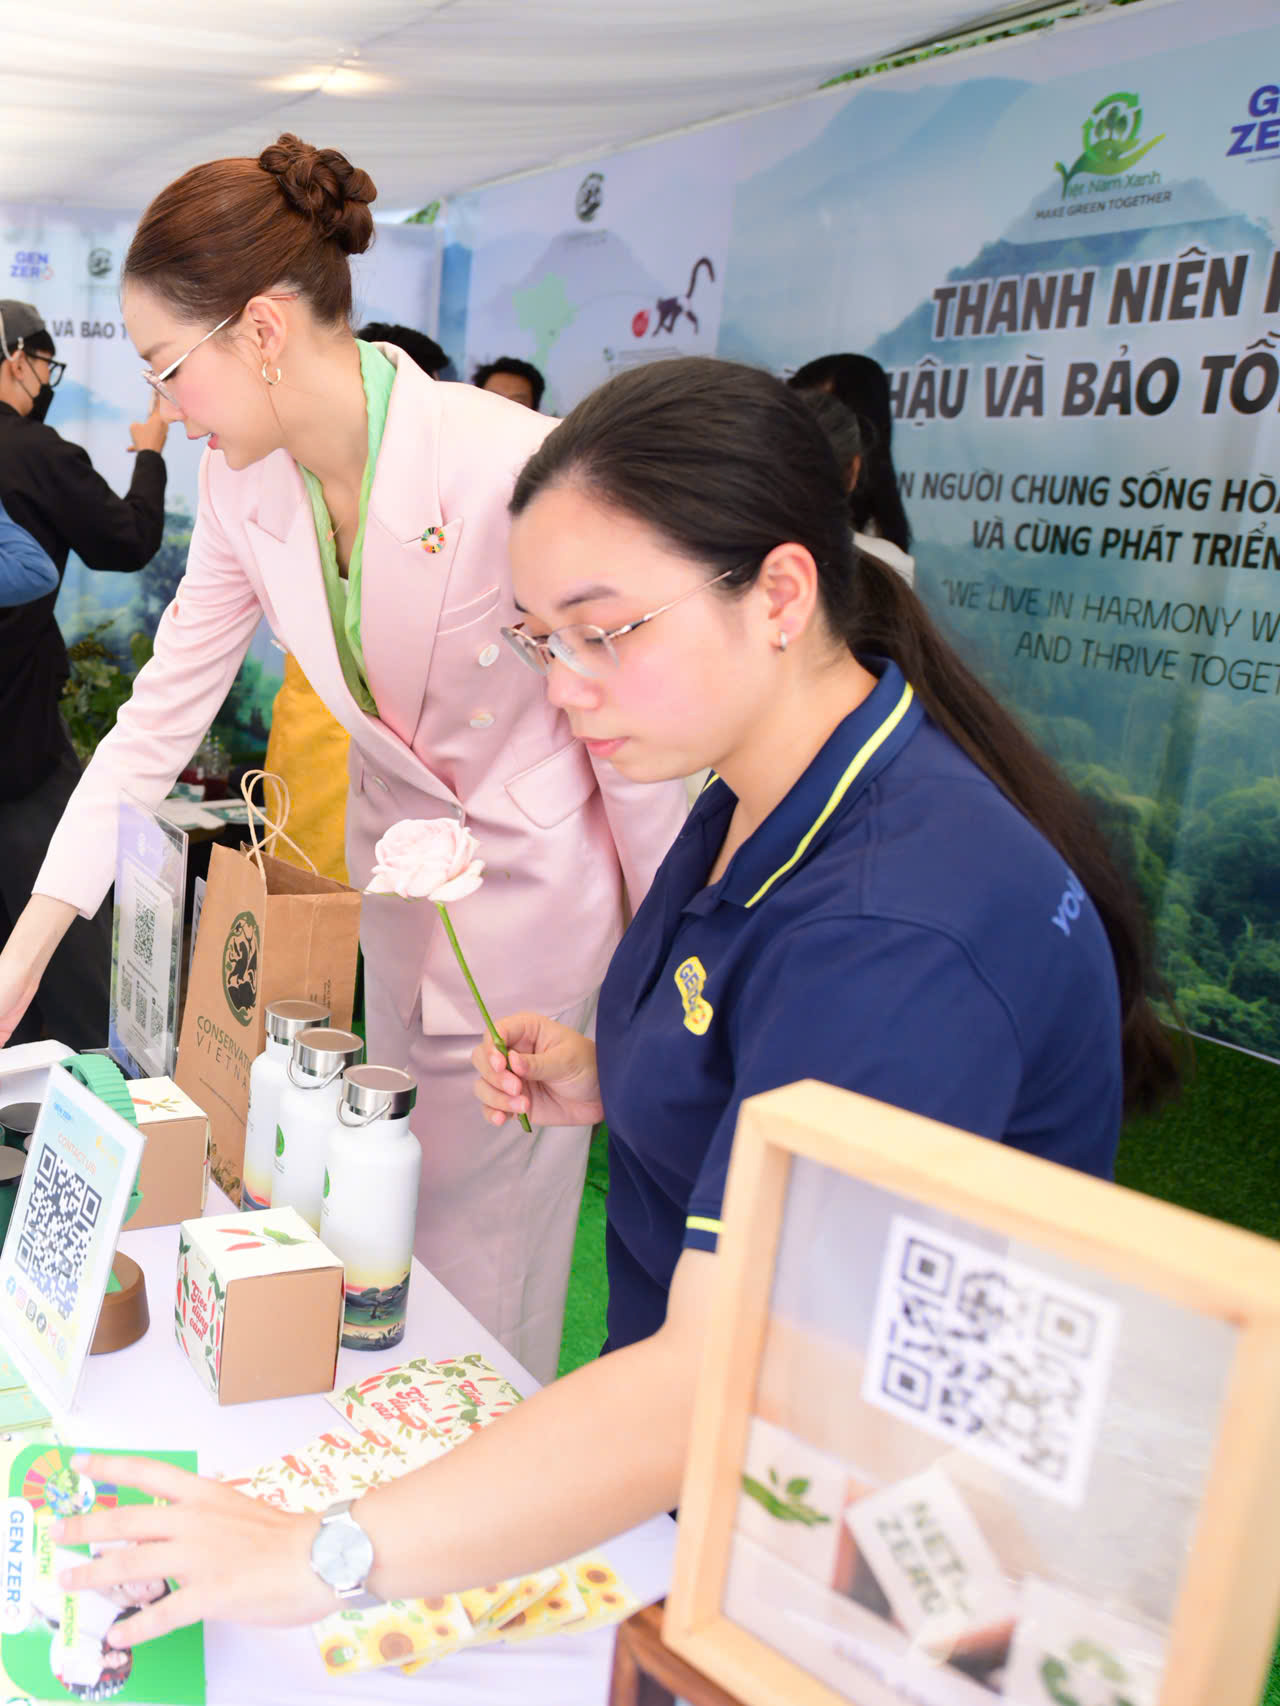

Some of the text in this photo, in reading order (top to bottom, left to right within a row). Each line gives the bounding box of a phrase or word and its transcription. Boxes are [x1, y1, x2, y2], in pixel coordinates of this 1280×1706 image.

[1067, 199, 1105, 217] GREEN
[1108, 190, 1173, 210] TOGETHER
[15, 250, 49, 265] GEN
[932, 271, 1096, 339] THANH
[1108, 246, 1250, 326] NIÊN
[985, 353, 1045, 418] VÀ
[1062, 344, 1181, 417] BẢO
[1201, 331, 1280, 415] TỒ
[921, 467, 1004, 502] NGƯỜI
[1011, 473, 1111, 507] CHUNG
[1120, 466, 1212, 512] SỐNG
[1221, 473, 1280, 514] HÒ
[973, 514, 1006, 550] VÀ
[1015, 517, 1092, 557] CÙNG
[1101, 523, 1183, 563] PHÁT
[988, 585, 1041, 616] LIVE
[1048, 590, 1073, 620] IN
[1082, 594, 1242, 638] HARMONY
[1014, 630, 1280, 697] AND THRIVE TOGET
[196, 1031, 248, 1090] VIETNA
[197, 1015, 252, 1078] CONSERVATI
[8, 1509, 25, 1554] GEN
